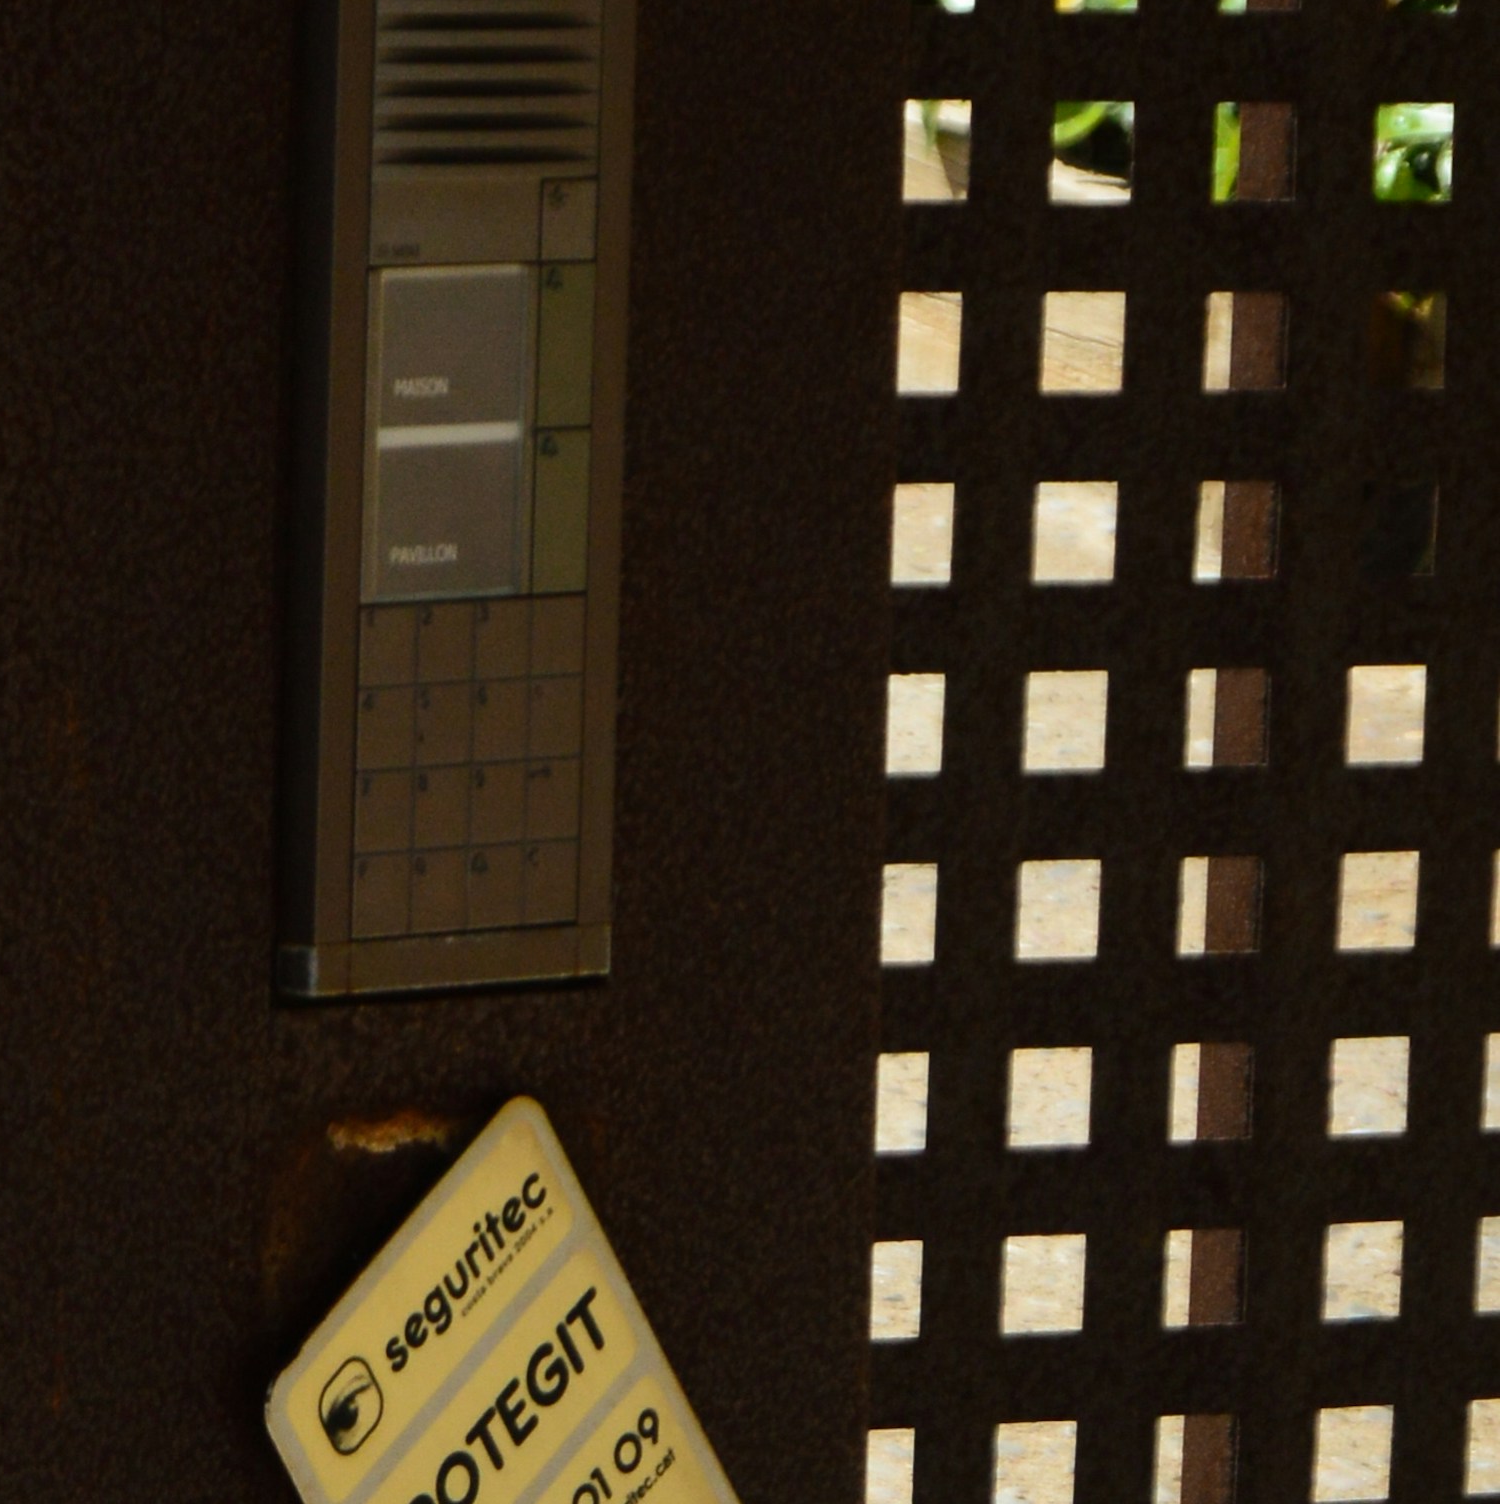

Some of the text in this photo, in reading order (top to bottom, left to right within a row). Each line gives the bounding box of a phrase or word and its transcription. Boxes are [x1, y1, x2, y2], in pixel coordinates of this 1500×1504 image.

[393, 376, 449, 398] MAISON
[389, 543, 458, 566] PAVILLON
[386, 1172, 546, 1372] seguritec
[614, 1408, 659, 1474] 09
